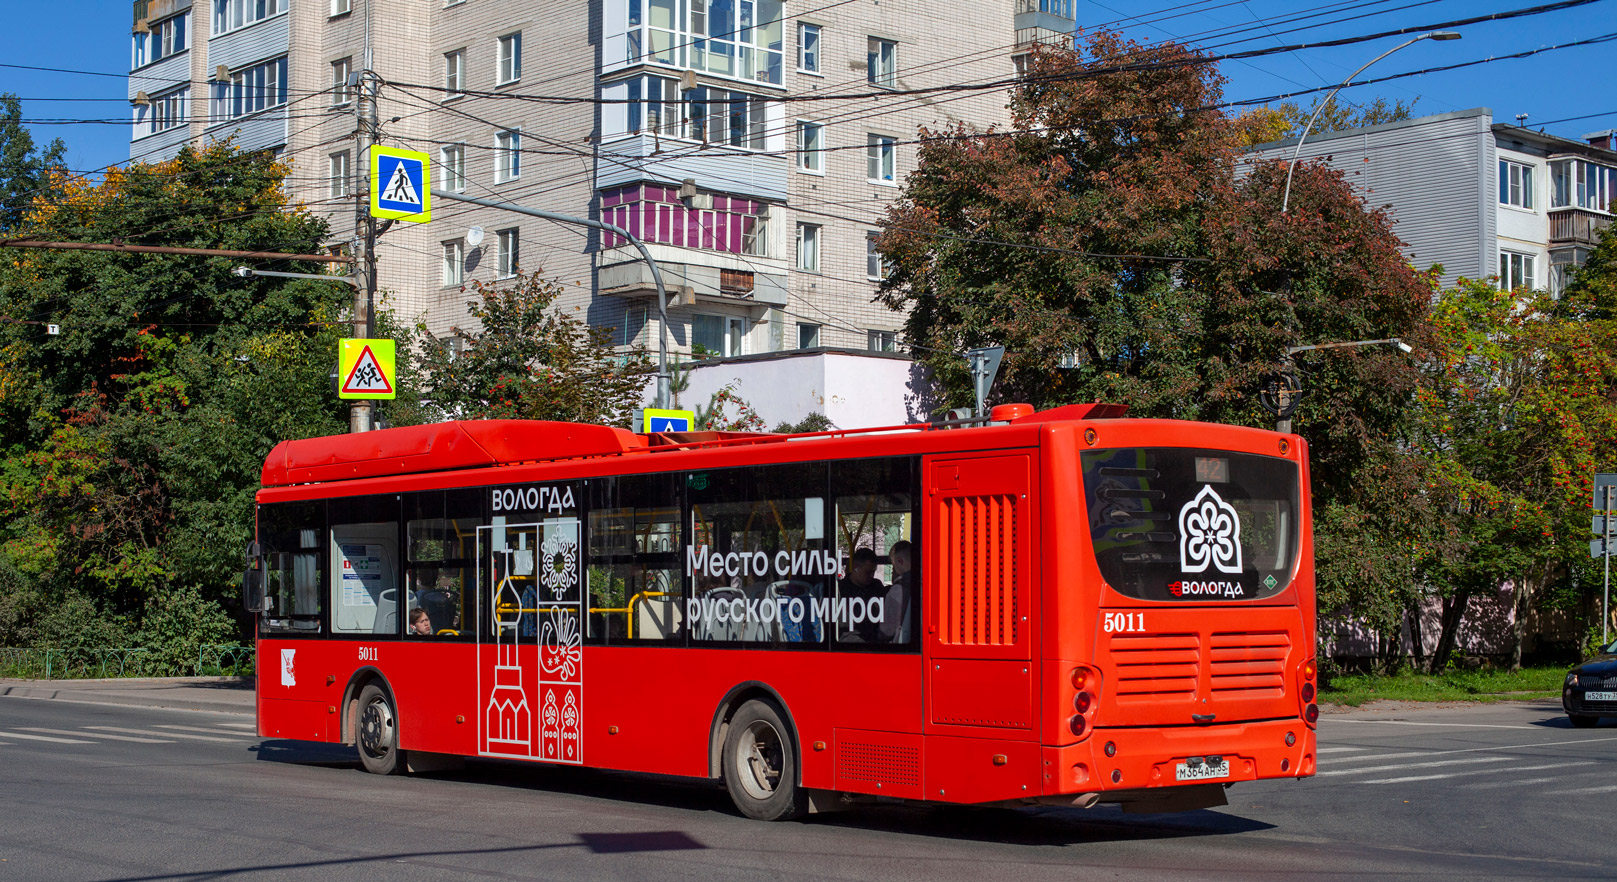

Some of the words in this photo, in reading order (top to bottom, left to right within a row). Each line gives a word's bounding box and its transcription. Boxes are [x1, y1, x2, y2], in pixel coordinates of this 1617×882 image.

[1197, 457, 1222, 480] 42
[492, 486, 576, 515] ВОЛОГДА
[686, 544, 769, 577] Место
[774, 549, 842, 576] силы
[1181, 581, 1244, 599] ВОЛОГДА
[686, 597, 805, 630] русского
[811, 596, 885, 632] мира
[1103, 612, 1146, 632] 5011
[358, 646, 378, 661] 5011
